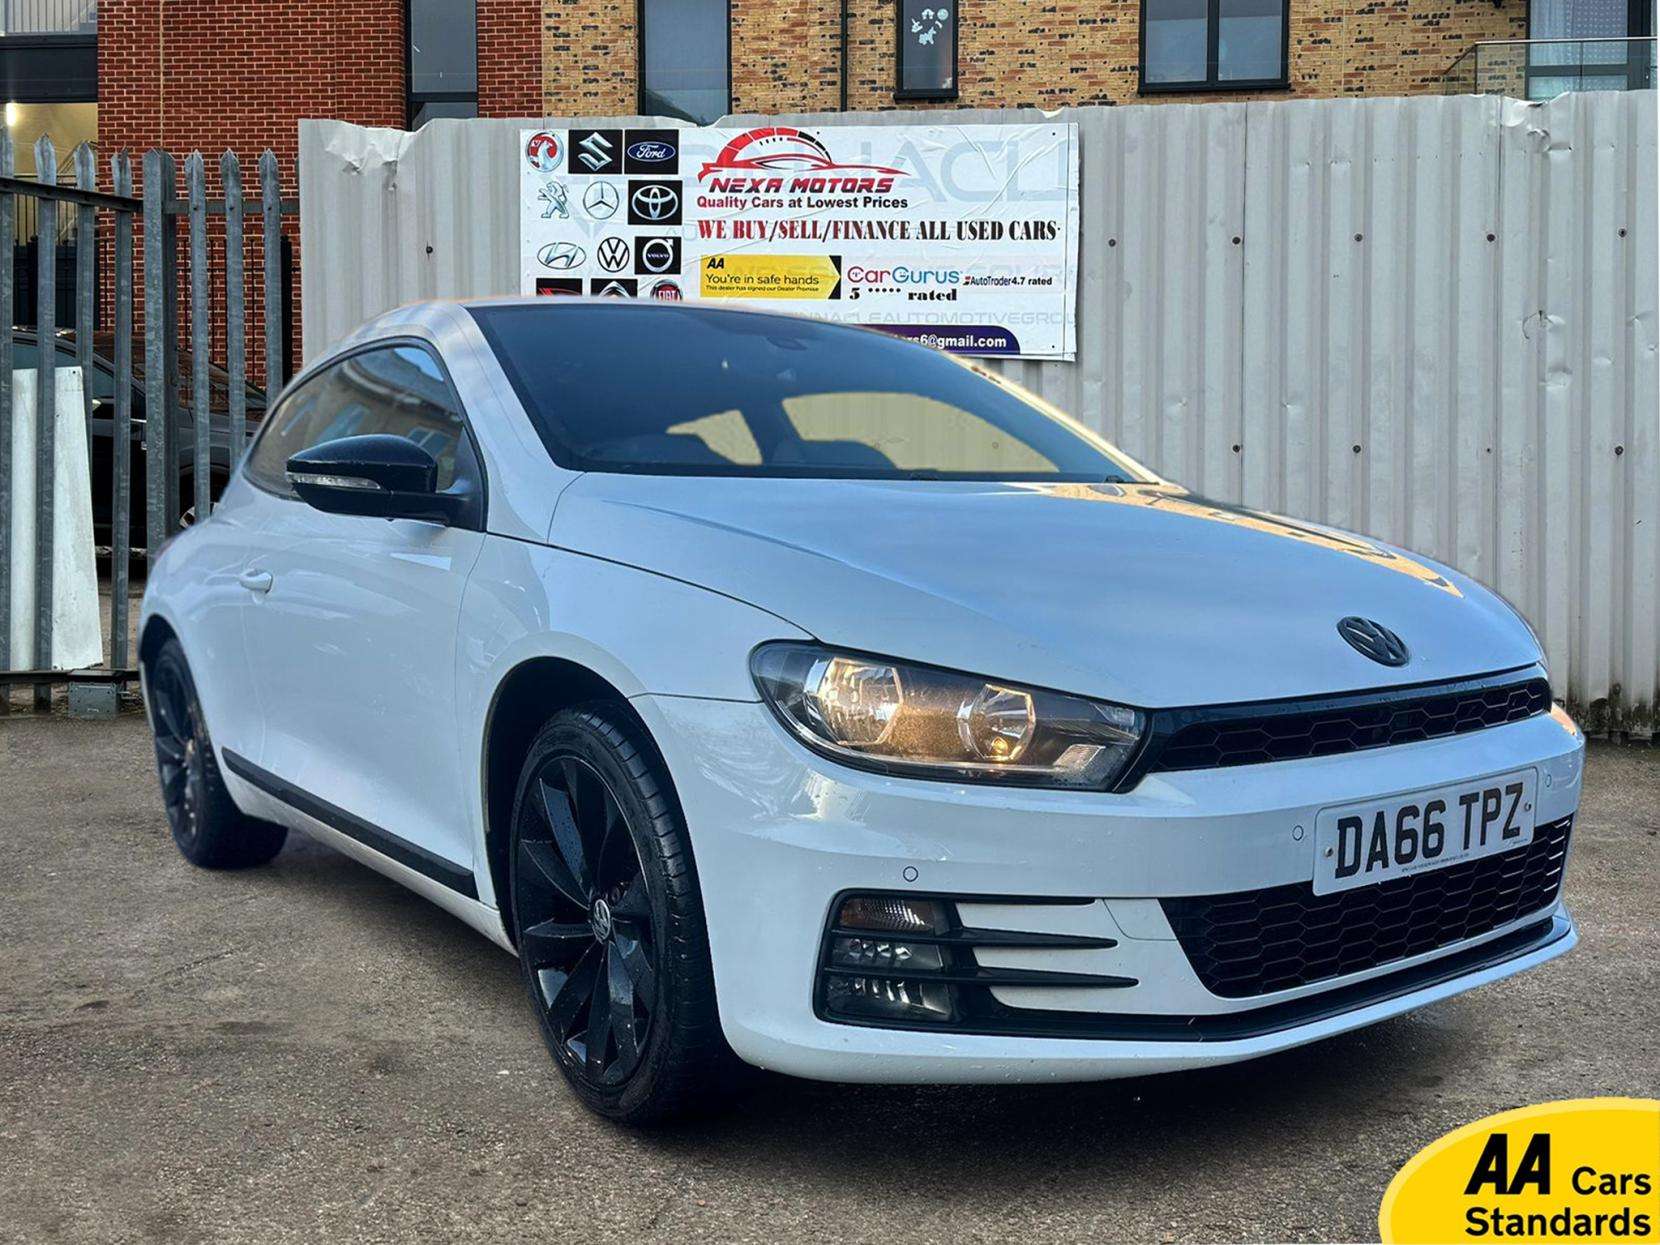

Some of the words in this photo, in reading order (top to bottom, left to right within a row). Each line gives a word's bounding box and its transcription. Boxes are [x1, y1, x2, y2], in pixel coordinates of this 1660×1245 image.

[635, 144, 666, 158] Ford
[709, 177, 783, 193] NEXA
[789, 177, 895, 193] MOTORS
[697, 195, 746, 210] Quality
[751, 196, 784, 208] Cars
[788, 197, 802, 208] at
[807, 196, 858, 208] Lowest
[863, 196, 908, 208] Prices
[697, 220, 726, 239] WE
[733, 220, 911, 242] BUY/SELL/FINANCE
[916, 220, 950, 240] ALL
[957, 221, 1004, 240] USED
[1009, 220, 1057, 240] CARS
[706, 258, 725, 269] AA
[706, 273, 741, 284] You're
[744, 274, 754, 284] in
[757, 274, 781, 285] safe
[784, 274, 820, 285] hands
[847, 266, 960, 284] CarGurus
[1028, 277, 1053, 286] rated
[849, 287, 860, 300] 5
[908, 288, 957, 301] rated
[1335, 799, 1447, 879] DA66
[1459, 782, 1524, 851] TPZ
